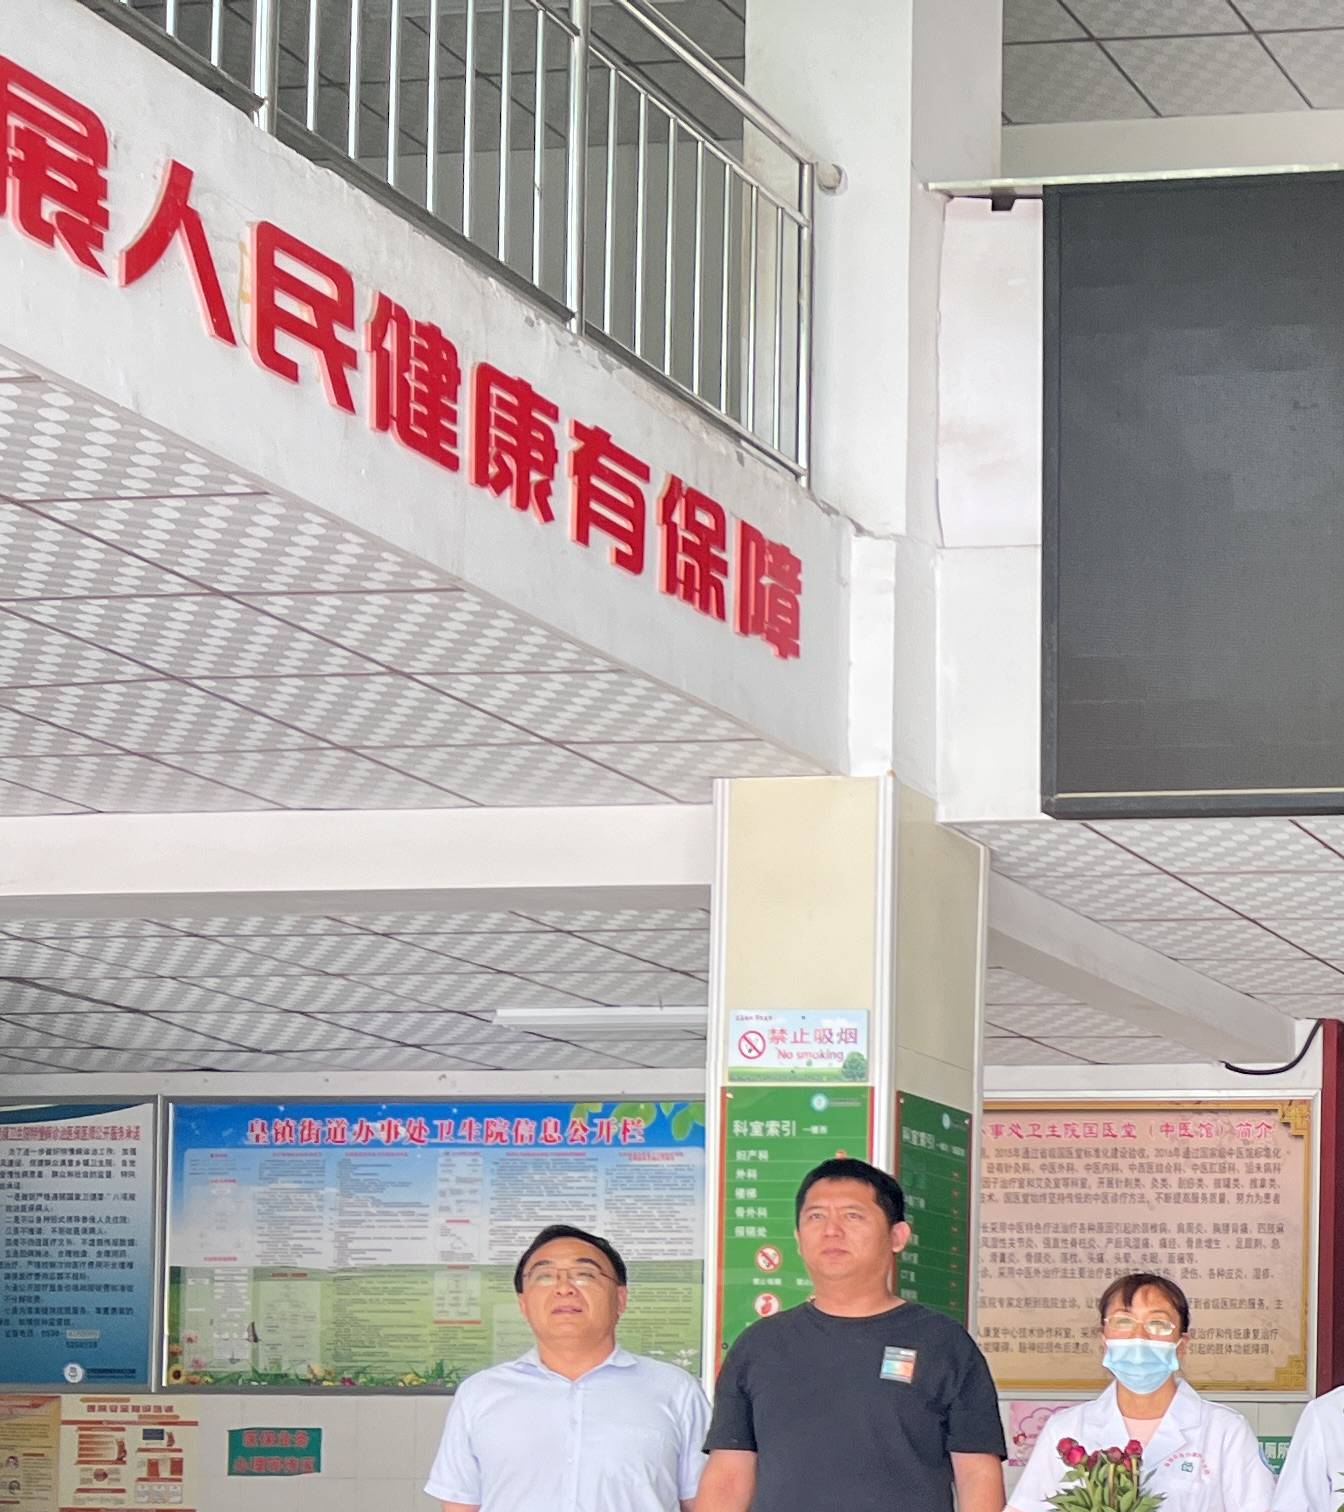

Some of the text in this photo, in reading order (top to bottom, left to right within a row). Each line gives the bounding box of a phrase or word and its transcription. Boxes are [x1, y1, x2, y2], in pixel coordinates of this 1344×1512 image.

[768, 1027, 858, 1045] 禁止吸烟
[777, 1049, 844, 1062] No smoking
[248, 1119, 645, 1145] 皇镇街道办事处卫生院信息公开栏
[733, 1120, 797, 1137] 科室索引
[982, 1121, 1272, 1140] 事处卫生院国医堂（中医馆）简介
